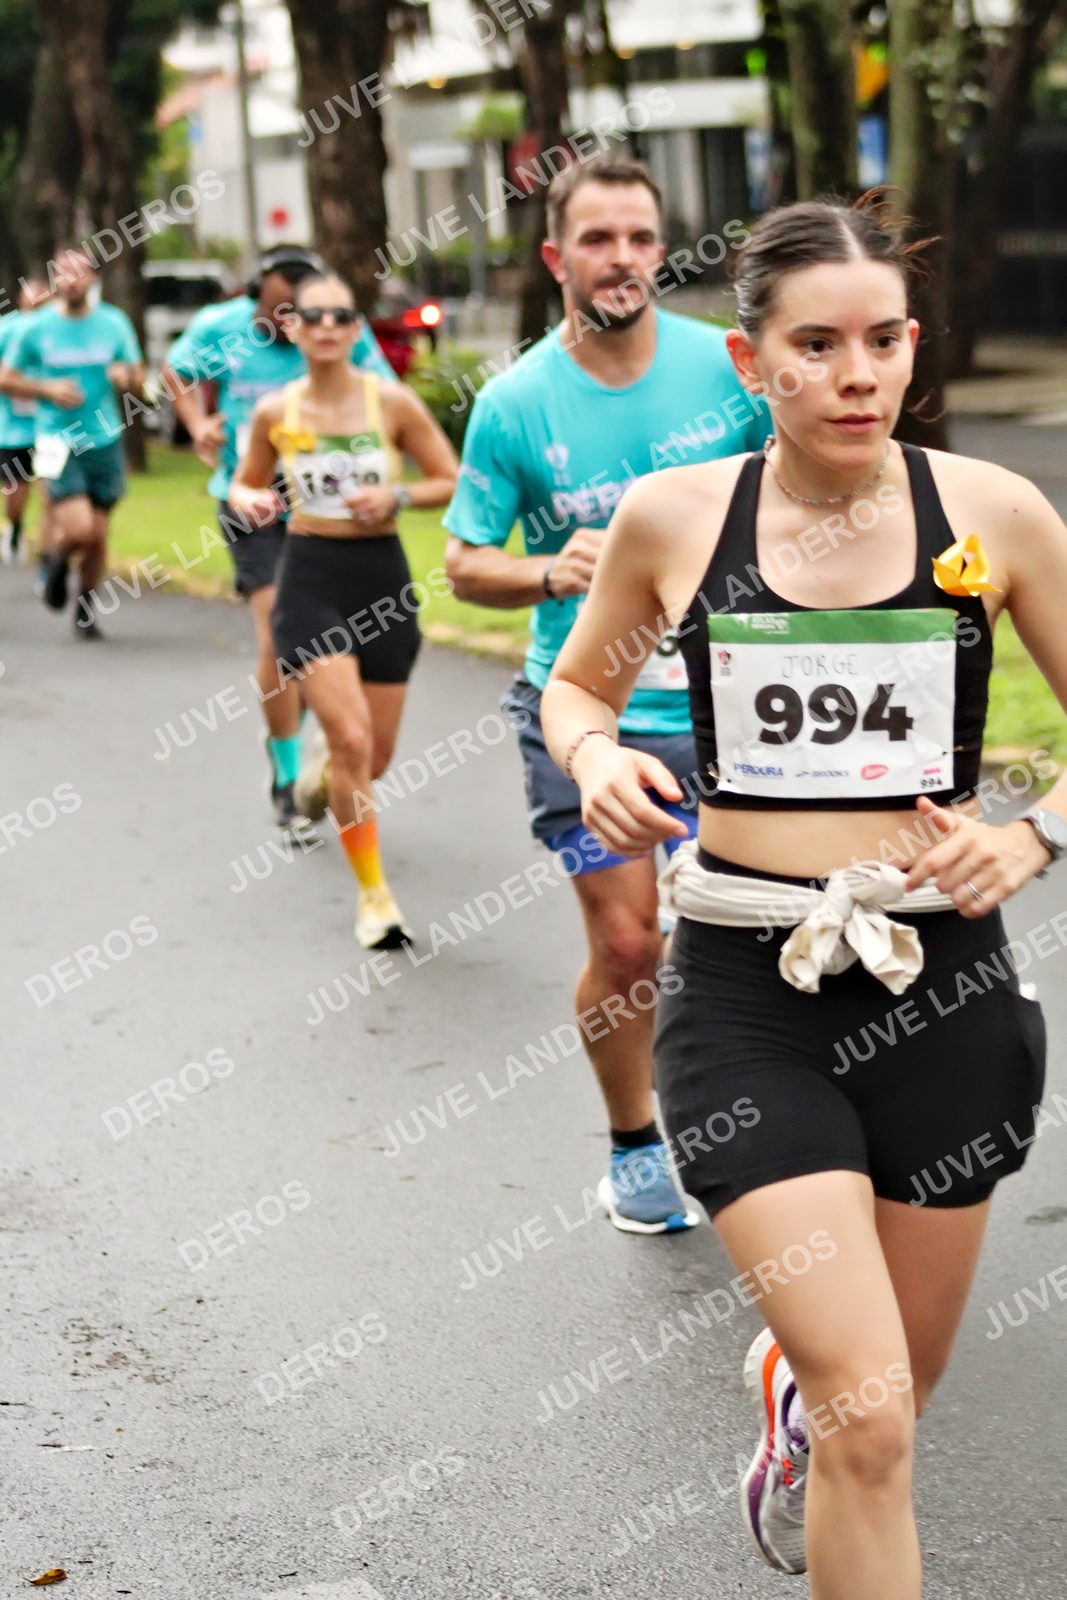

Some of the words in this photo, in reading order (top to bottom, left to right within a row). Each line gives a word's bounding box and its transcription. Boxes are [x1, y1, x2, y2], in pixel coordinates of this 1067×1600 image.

[782, 655, 858, 678] JORGE
[755, 684, 913, 745] 994
[920, 778, 942, 788] 994
